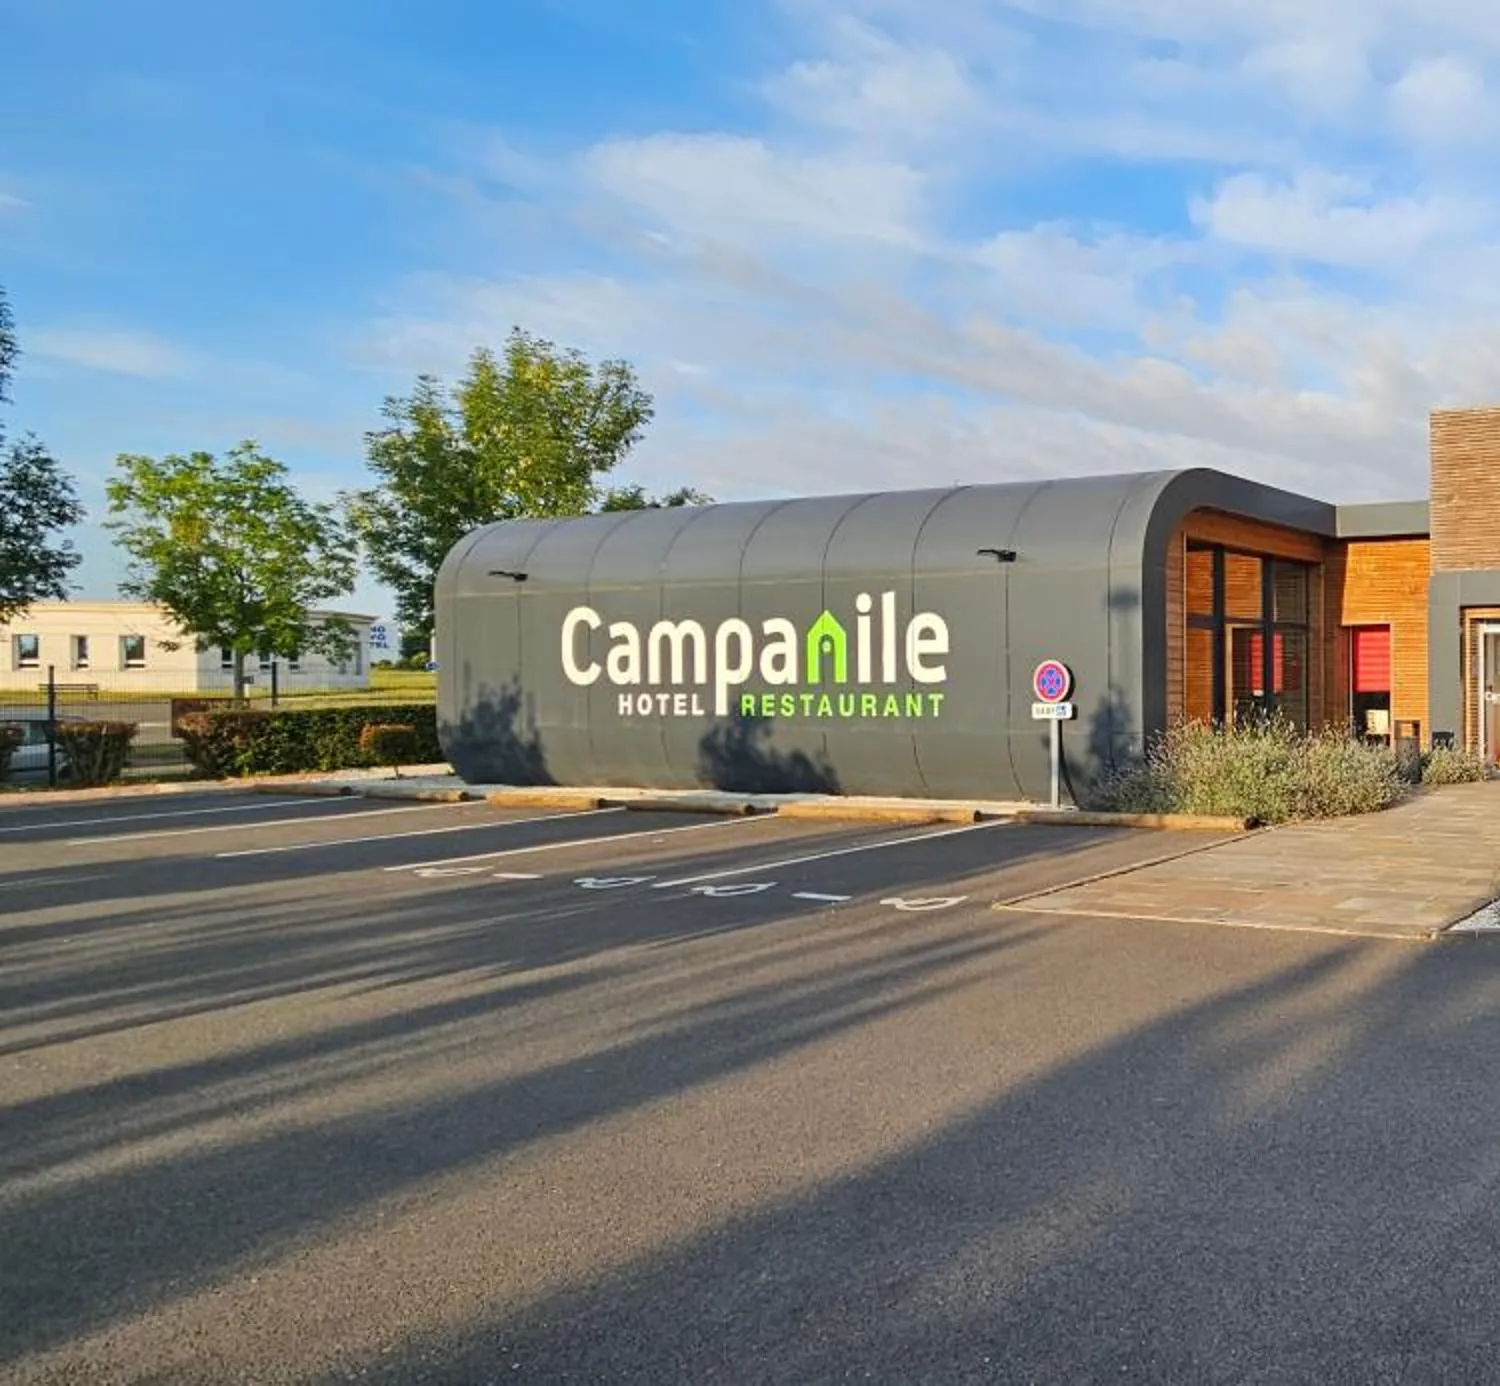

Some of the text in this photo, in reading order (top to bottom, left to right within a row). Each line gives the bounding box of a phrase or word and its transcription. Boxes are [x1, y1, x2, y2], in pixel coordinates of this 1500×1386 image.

[561, 591, 949, 716] Campanile
[618, 693, 944, 717] HOTEL RESTAURANT
